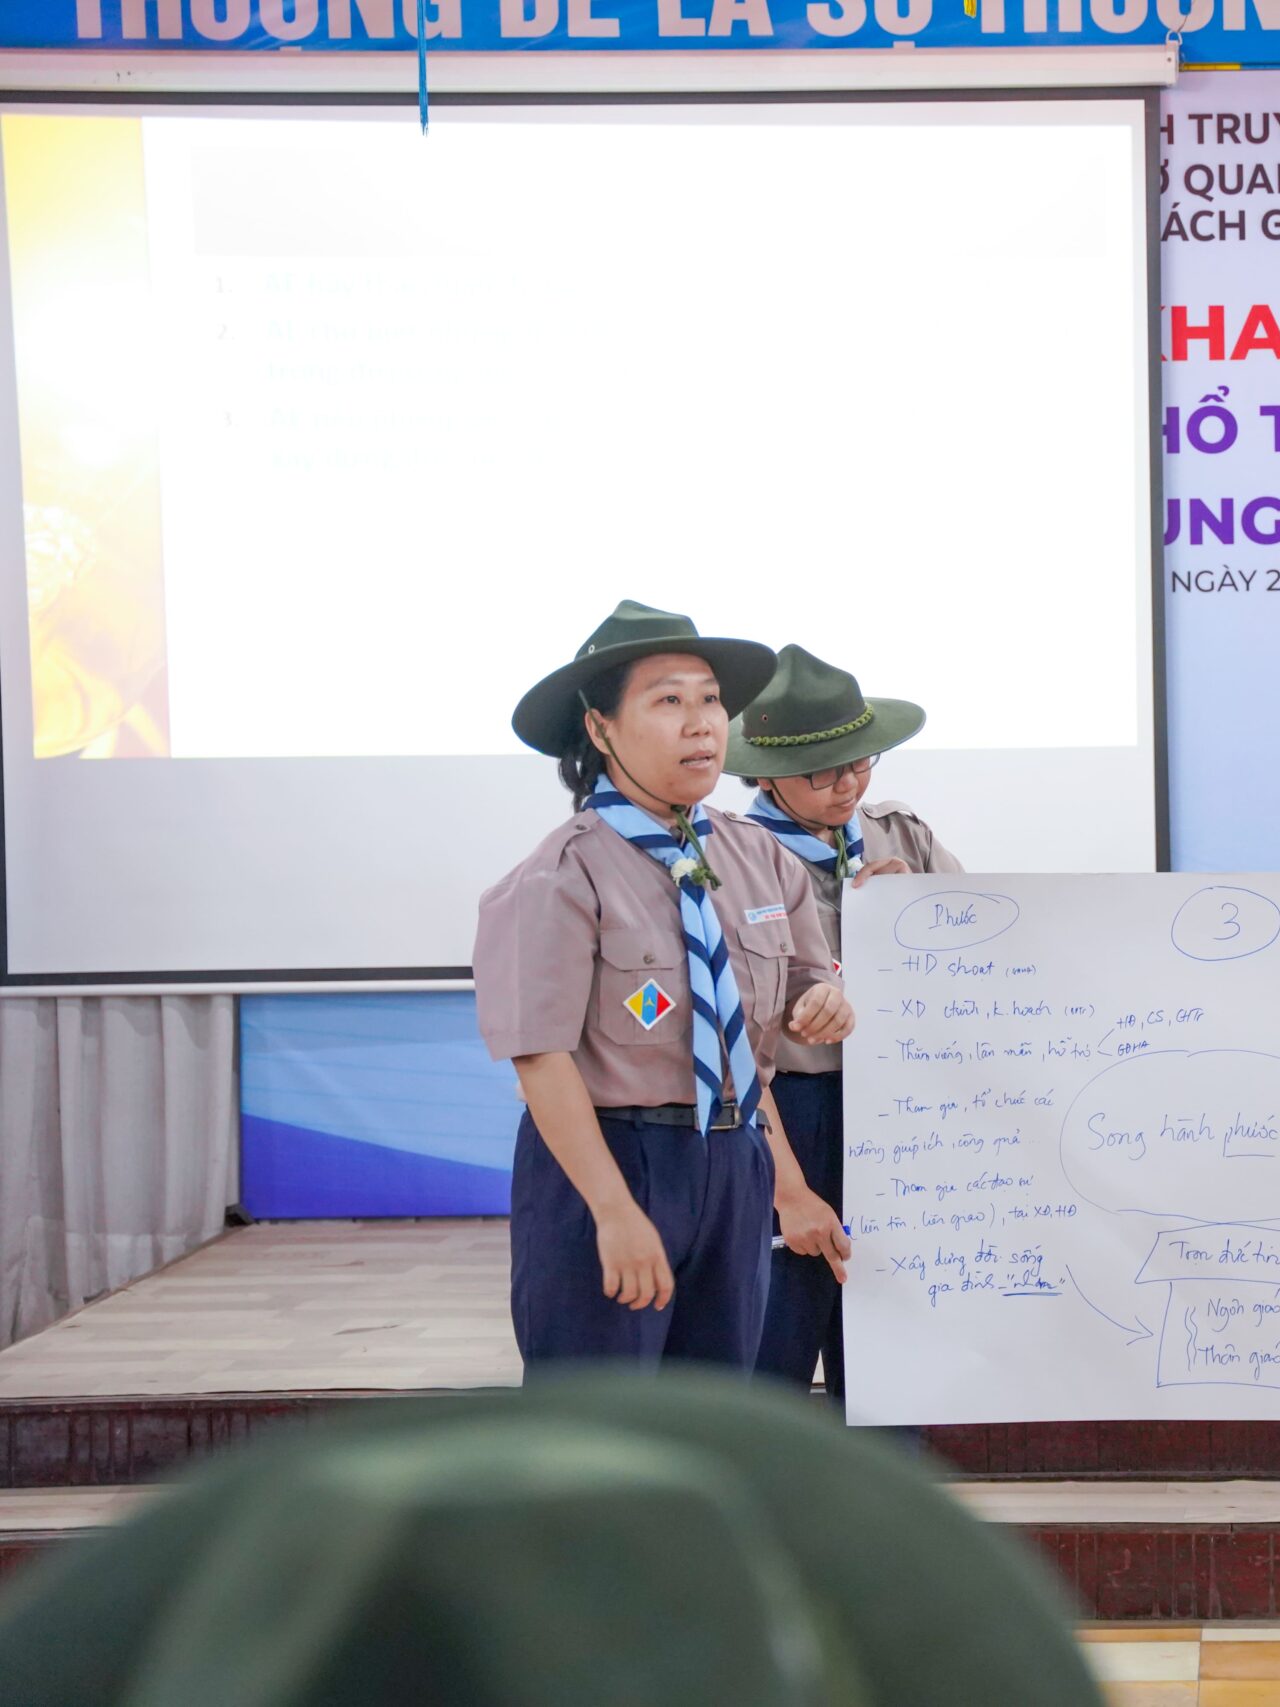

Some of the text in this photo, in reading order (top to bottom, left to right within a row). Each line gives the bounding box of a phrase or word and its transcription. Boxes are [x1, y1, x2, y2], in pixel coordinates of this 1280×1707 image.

[1171, 565, 1257, 593] NGÀY
[1212, 902, 1241, 941] 3
[1088, 1112, 1147, 1161] Song
